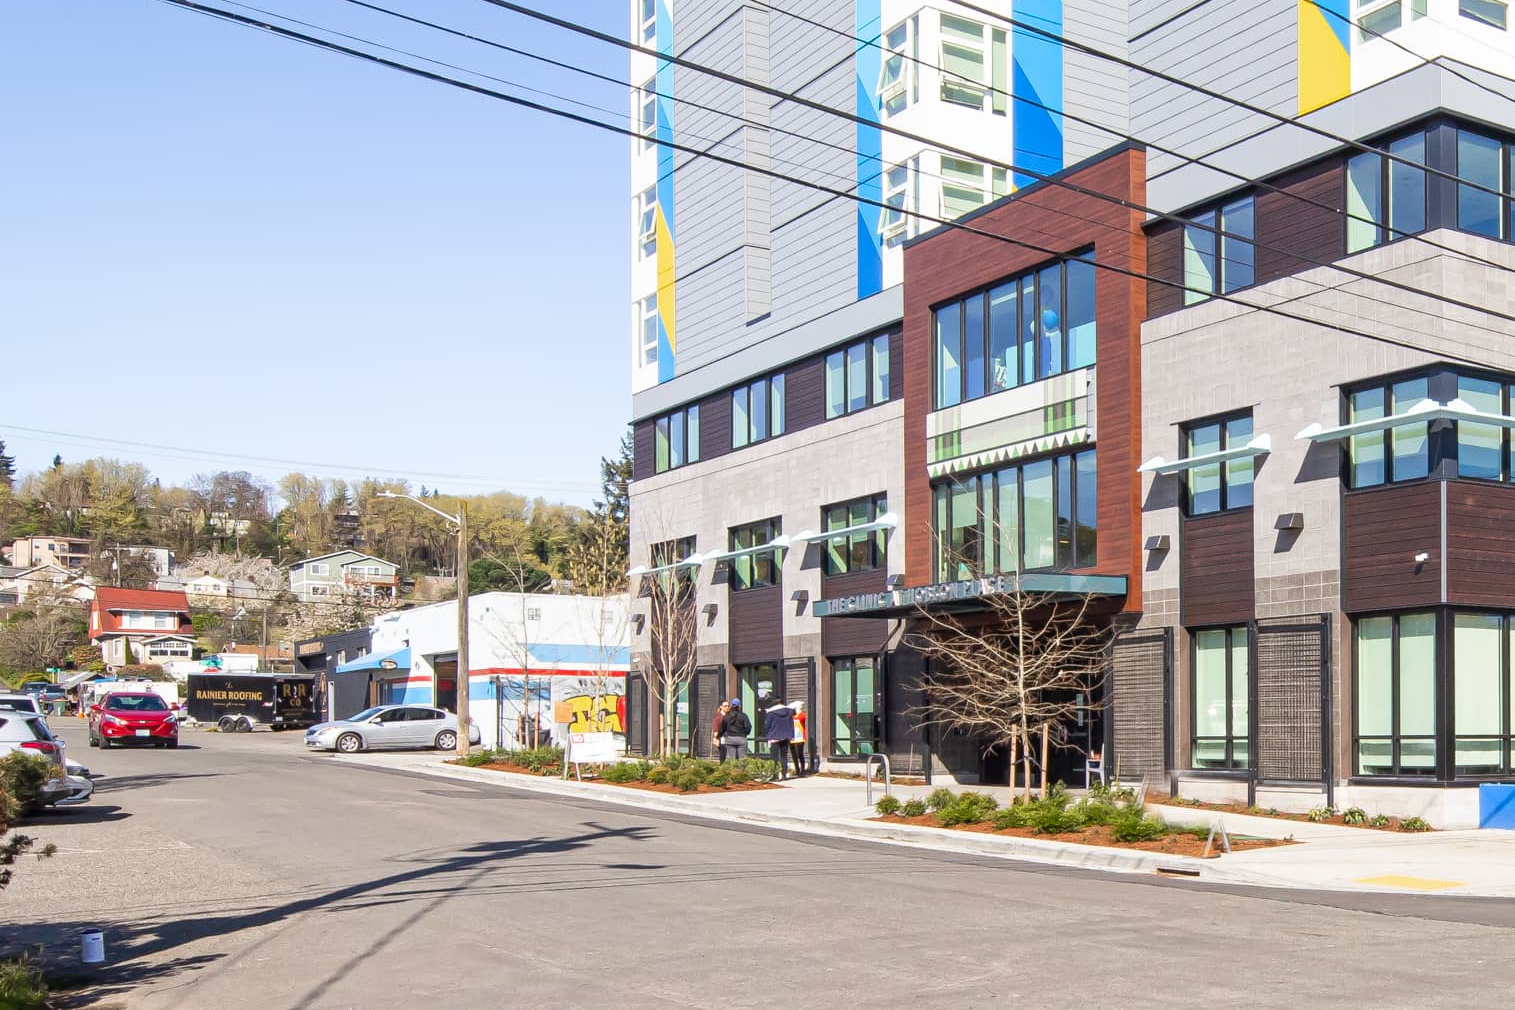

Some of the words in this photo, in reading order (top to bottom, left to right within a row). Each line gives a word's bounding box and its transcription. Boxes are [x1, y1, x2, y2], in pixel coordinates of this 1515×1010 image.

[827, 597, 846, 615] THE
[848, 591, 885, 612] CLINIC
[196, 690, 227, 700] RAINIER
[228, 691, 263, 701] ROOFING
[282, 683, 291, 697] R
[299, 683, 306, 697] R
[289, 698, 302, 707] CO
